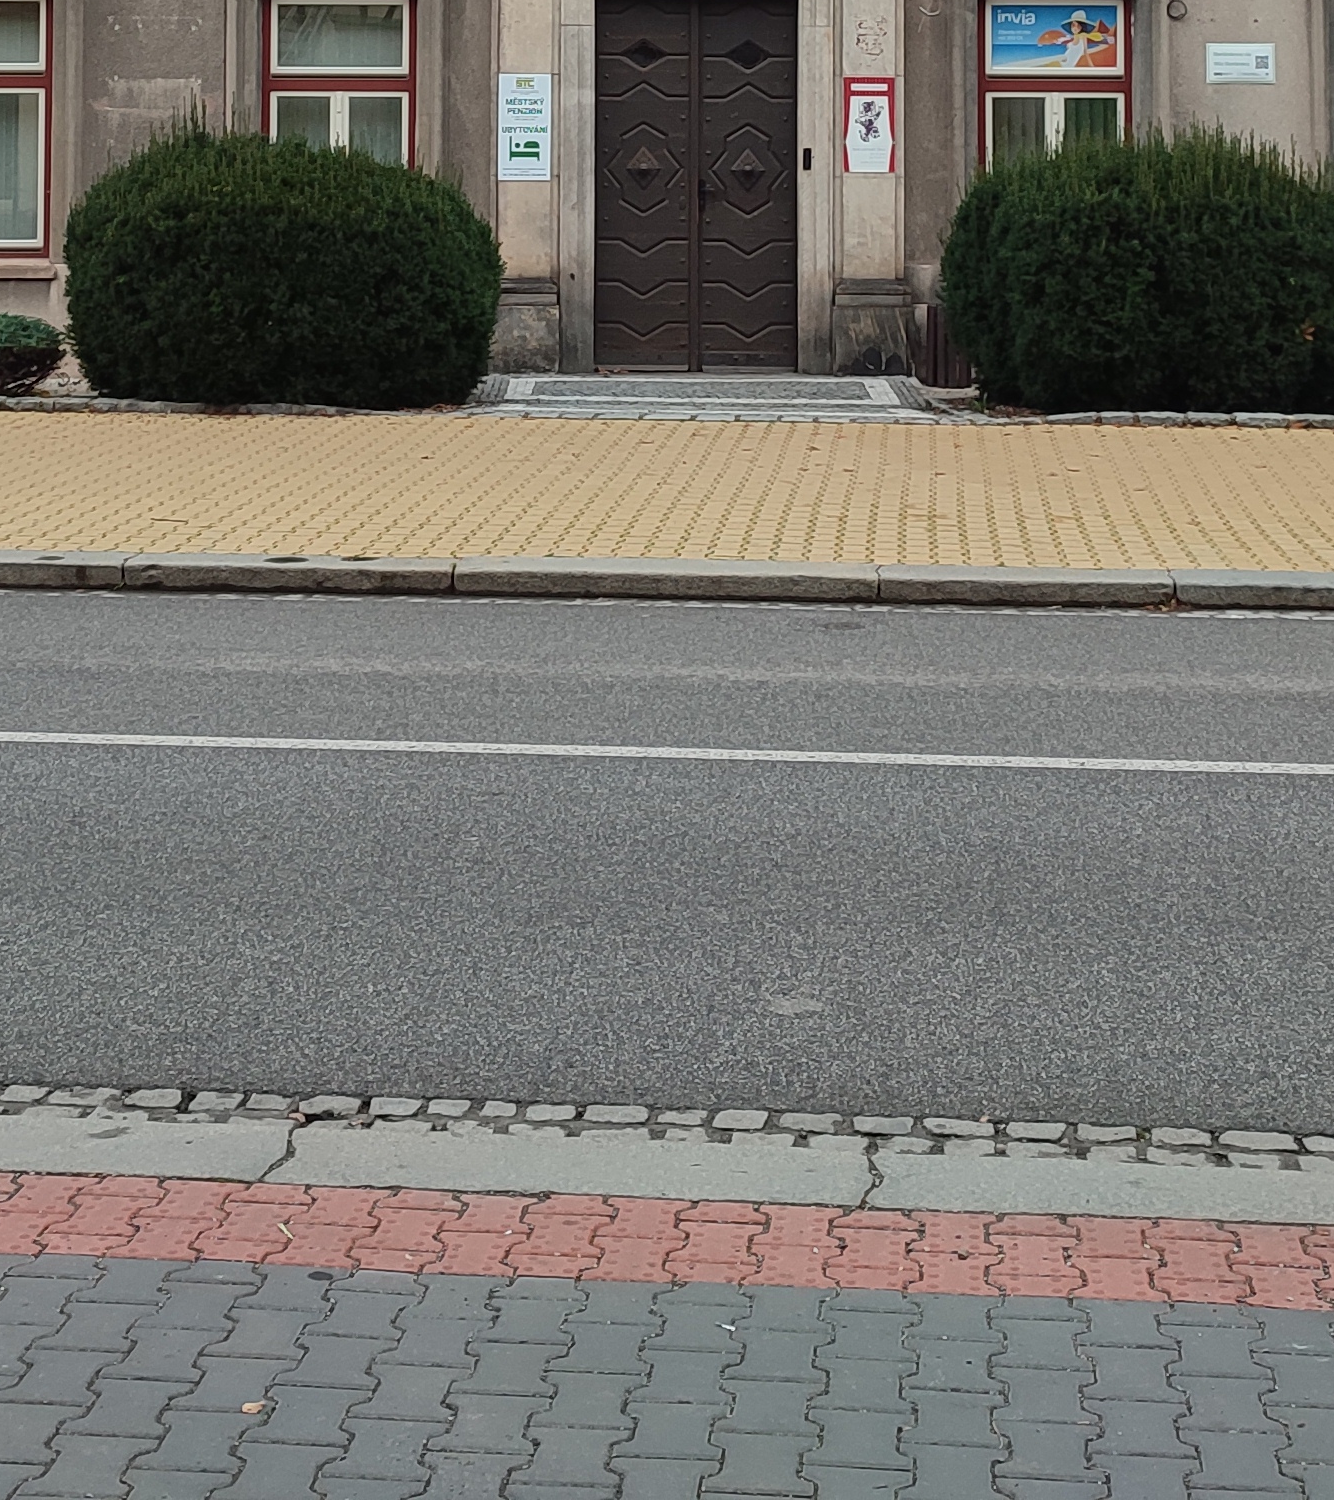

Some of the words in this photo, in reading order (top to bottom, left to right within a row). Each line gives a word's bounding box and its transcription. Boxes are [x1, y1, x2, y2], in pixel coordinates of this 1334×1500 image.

[997, 9, 1036, 25] invia
[505, 96, 544, 105] MĚSTSKÝ
[502, 125, 548, 133] UBYTOVÁNÍ
